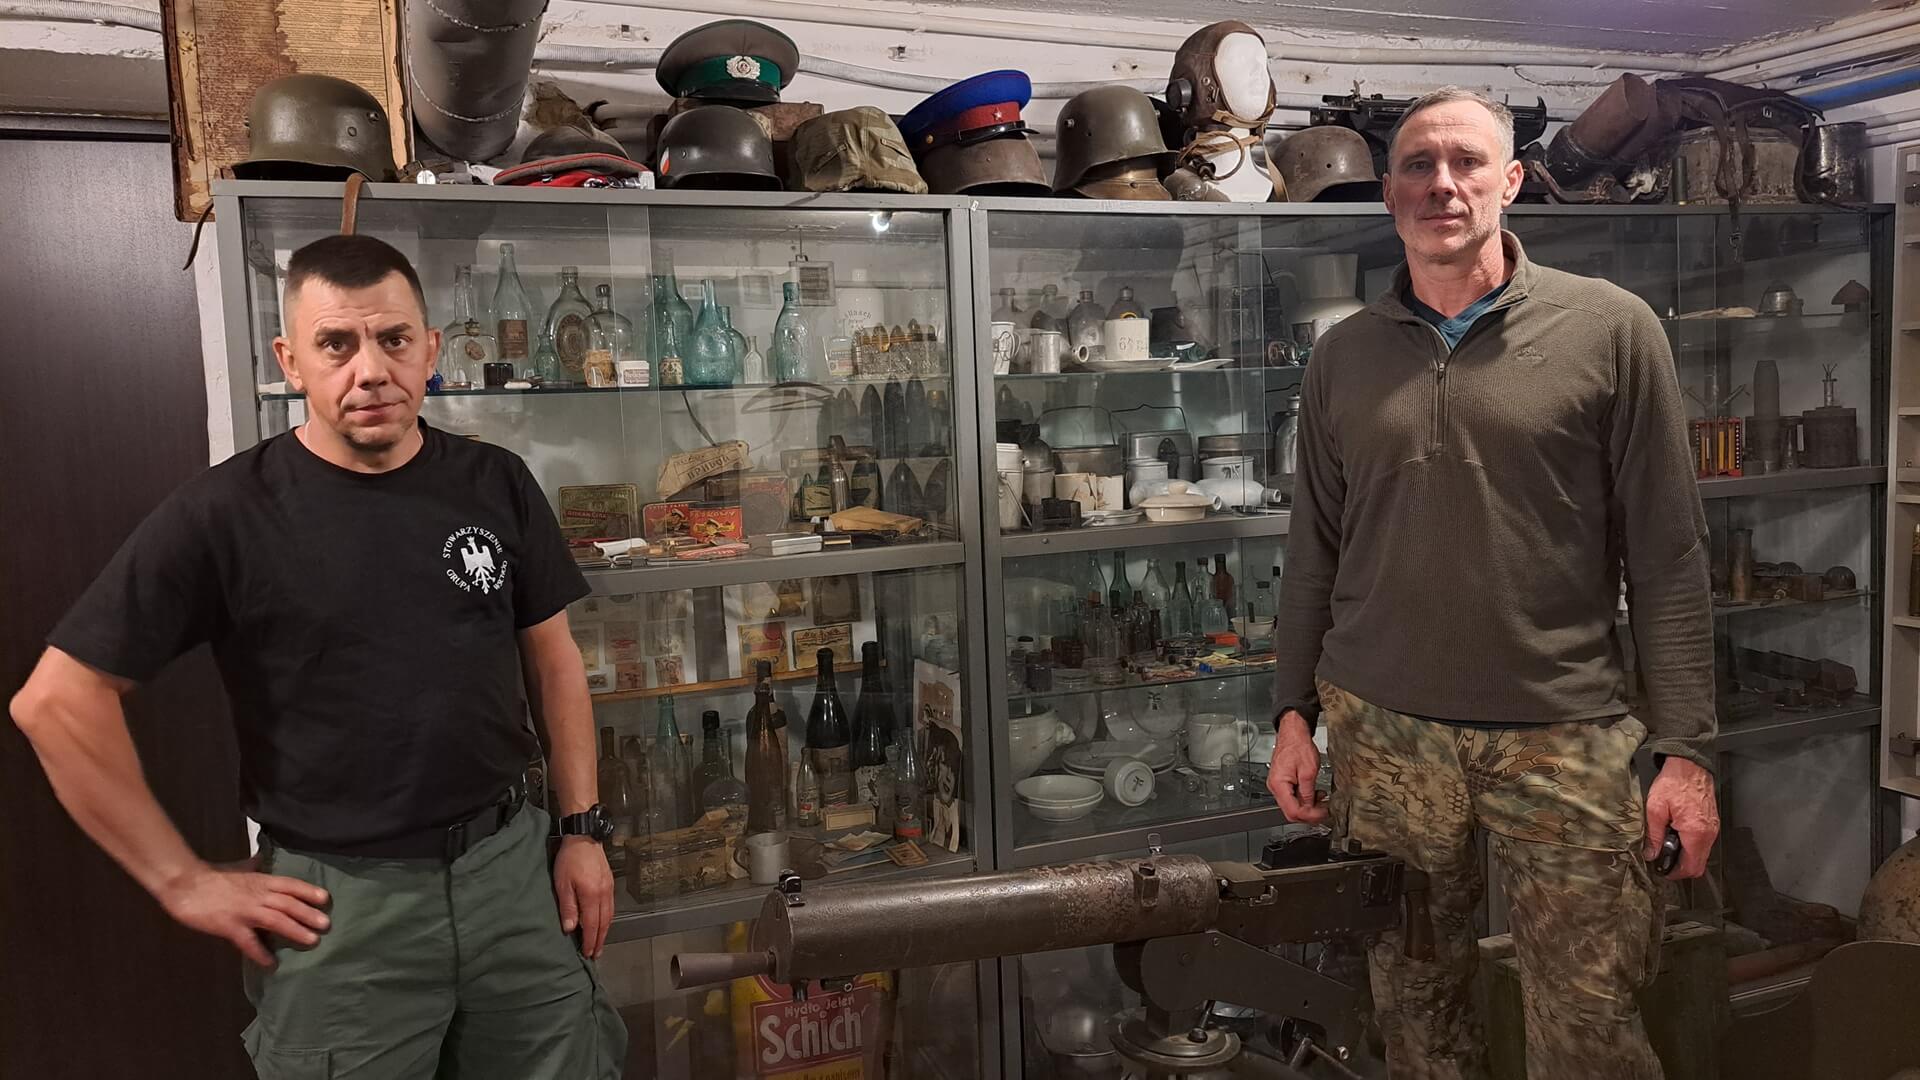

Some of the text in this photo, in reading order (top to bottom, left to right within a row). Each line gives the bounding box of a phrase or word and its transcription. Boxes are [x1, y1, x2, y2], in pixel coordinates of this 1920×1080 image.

[443, 526, 503, 559] STOWARZYSZENIE
[446, 568, 471, 592] GRUPA
[760, 1005, 869, 1064] Schich
